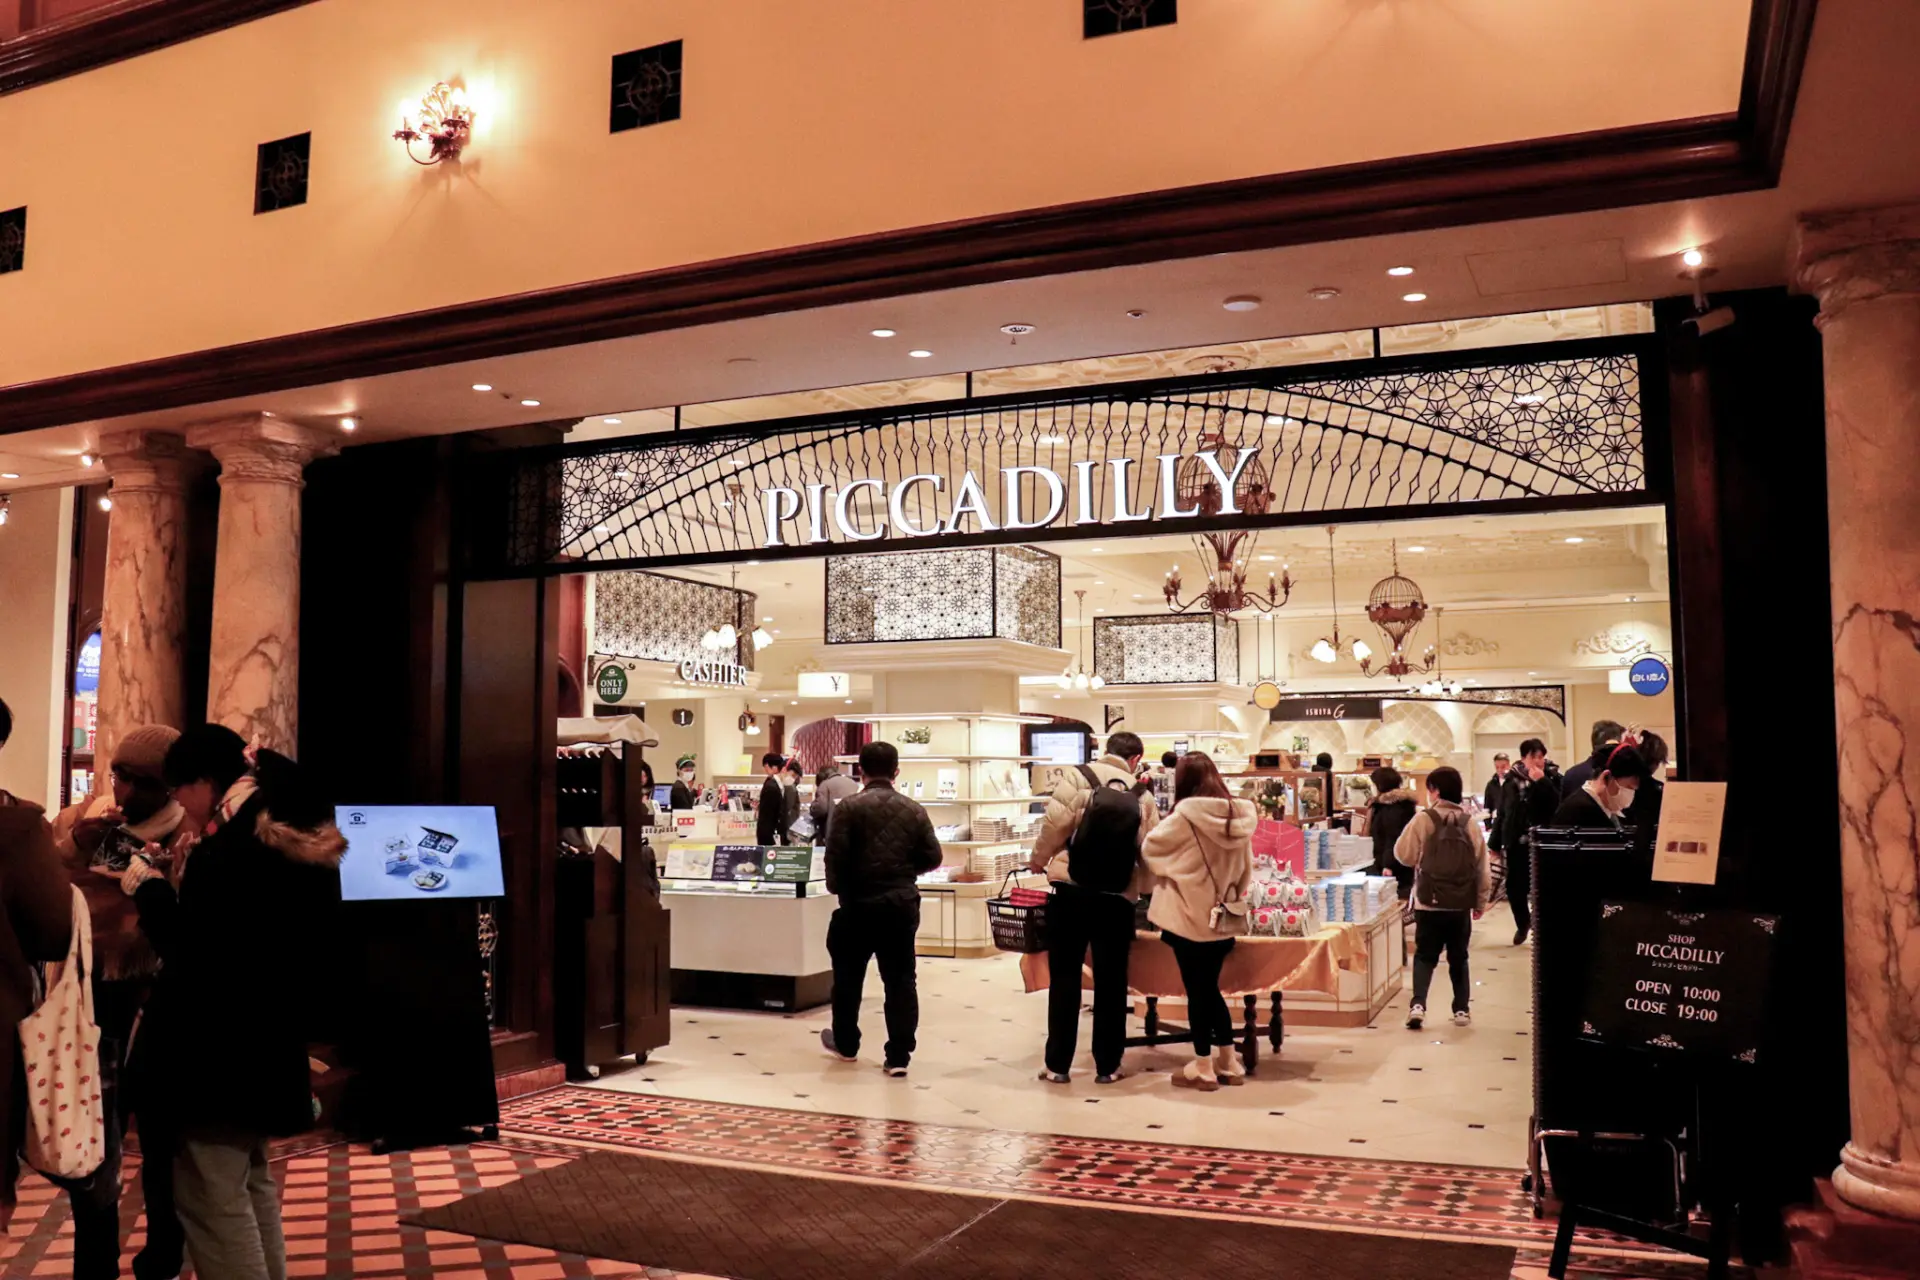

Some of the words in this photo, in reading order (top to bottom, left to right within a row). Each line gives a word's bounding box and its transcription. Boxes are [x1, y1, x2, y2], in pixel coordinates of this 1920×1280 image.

[761, 448, 1259, 548] PICCADILLY
[600, 679, 623, 688] ONLY
[680, 658, 749, 686] CASHIER
[600, 687, 623, 695] HERE
[680, 711, 686, 725] 1
[1668, 933, 1696, 945] SHOP
[1636, 942, 1725, 965] PICCADILLY
[1635, 979, 1672, 995] OPEN
[1682, 985, 1721, 1002] 10:00
[1625, 997, 1668, 1016] CLOSE
[1677, 1003, 1718, 1023] 19:00
